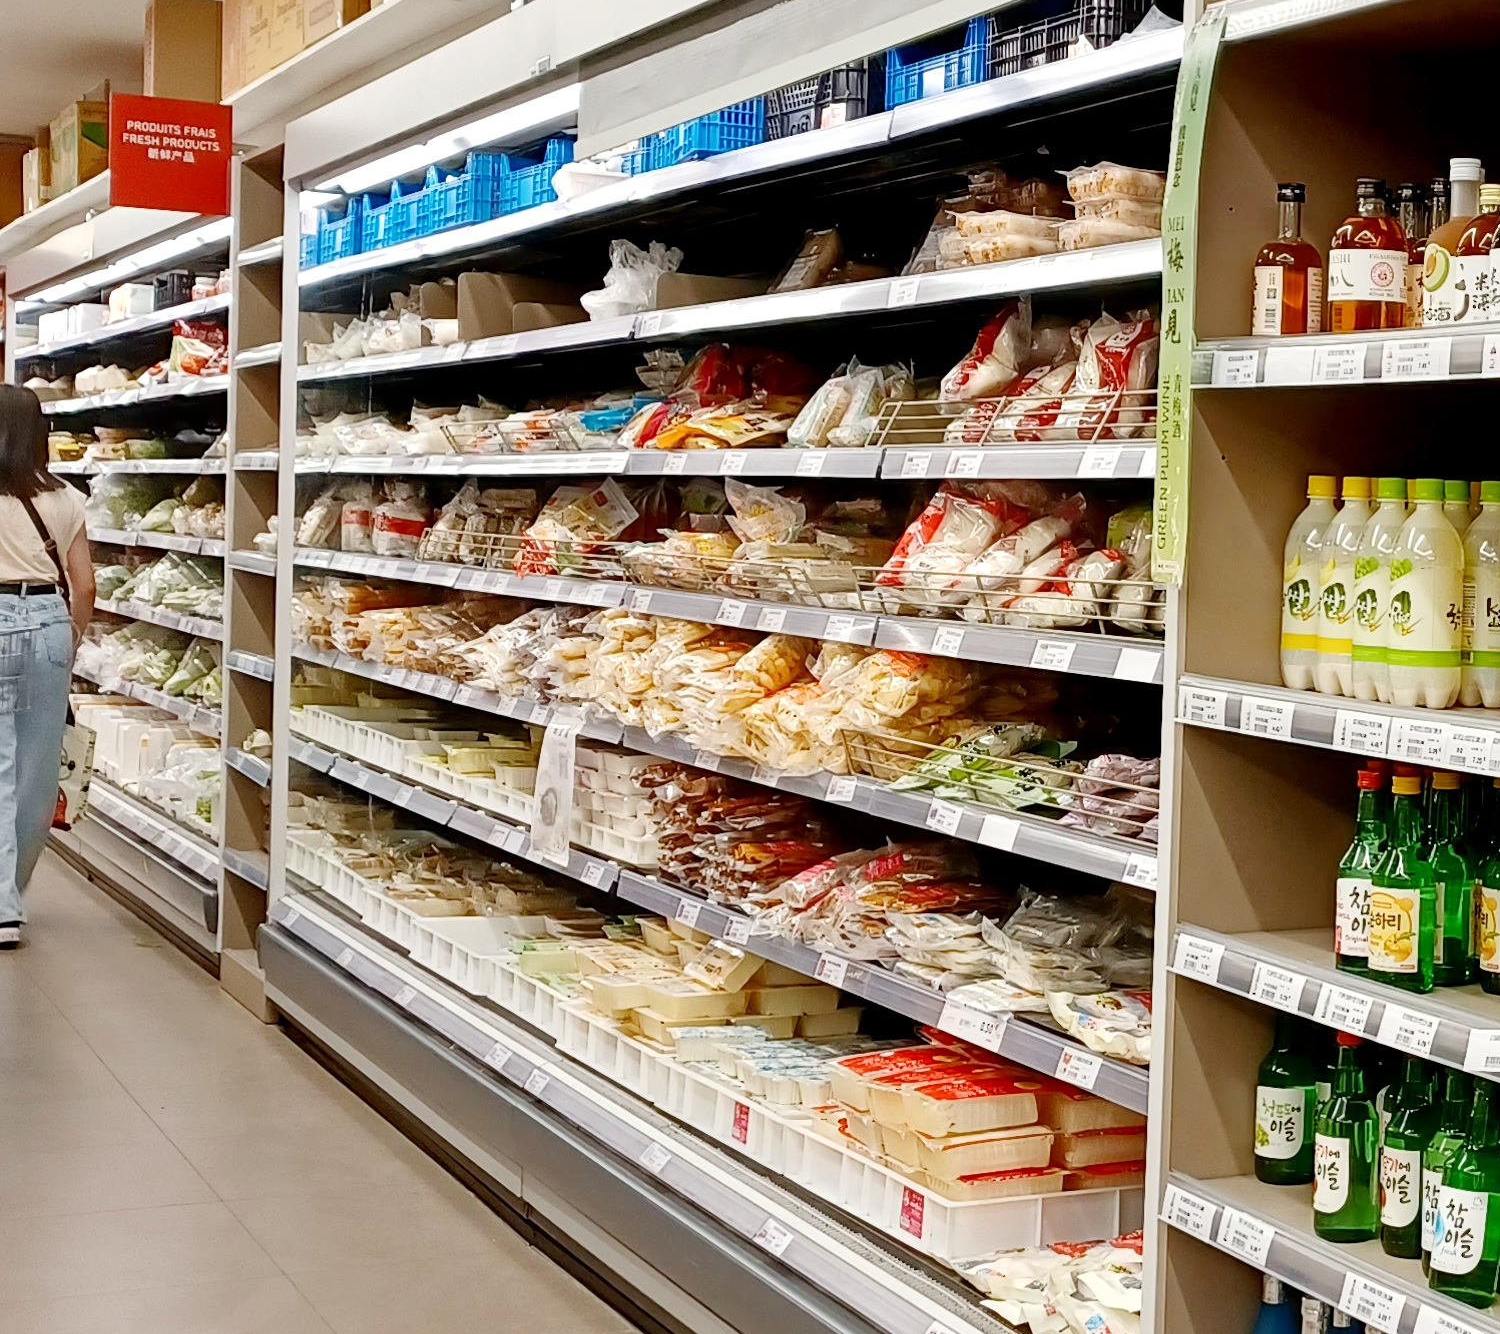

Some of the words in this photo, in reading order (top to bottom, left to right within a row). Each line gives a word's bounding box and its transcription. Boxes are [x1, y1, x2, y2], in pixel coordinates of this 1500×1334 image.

[123, 132, 160, 146] FRESH
[163, 137, 221, 152] PRODUCTS
[126, 119, 181, 136] PRODUITS
[184, 125, 216, 139] FRAIS
[1161, 374, 1171, 417] WINE
[1159, 422, 1169, 482] PLUM
[1156, 486, 1167, 550] GREEN
[1270, 1118, 1296, 1142] 이슬
[1385, 1172, 1411, 1203] 이슬
[1445, 1197, 1470, 1229] 참
[1443, 1227, 1475, 1259] 이슬
